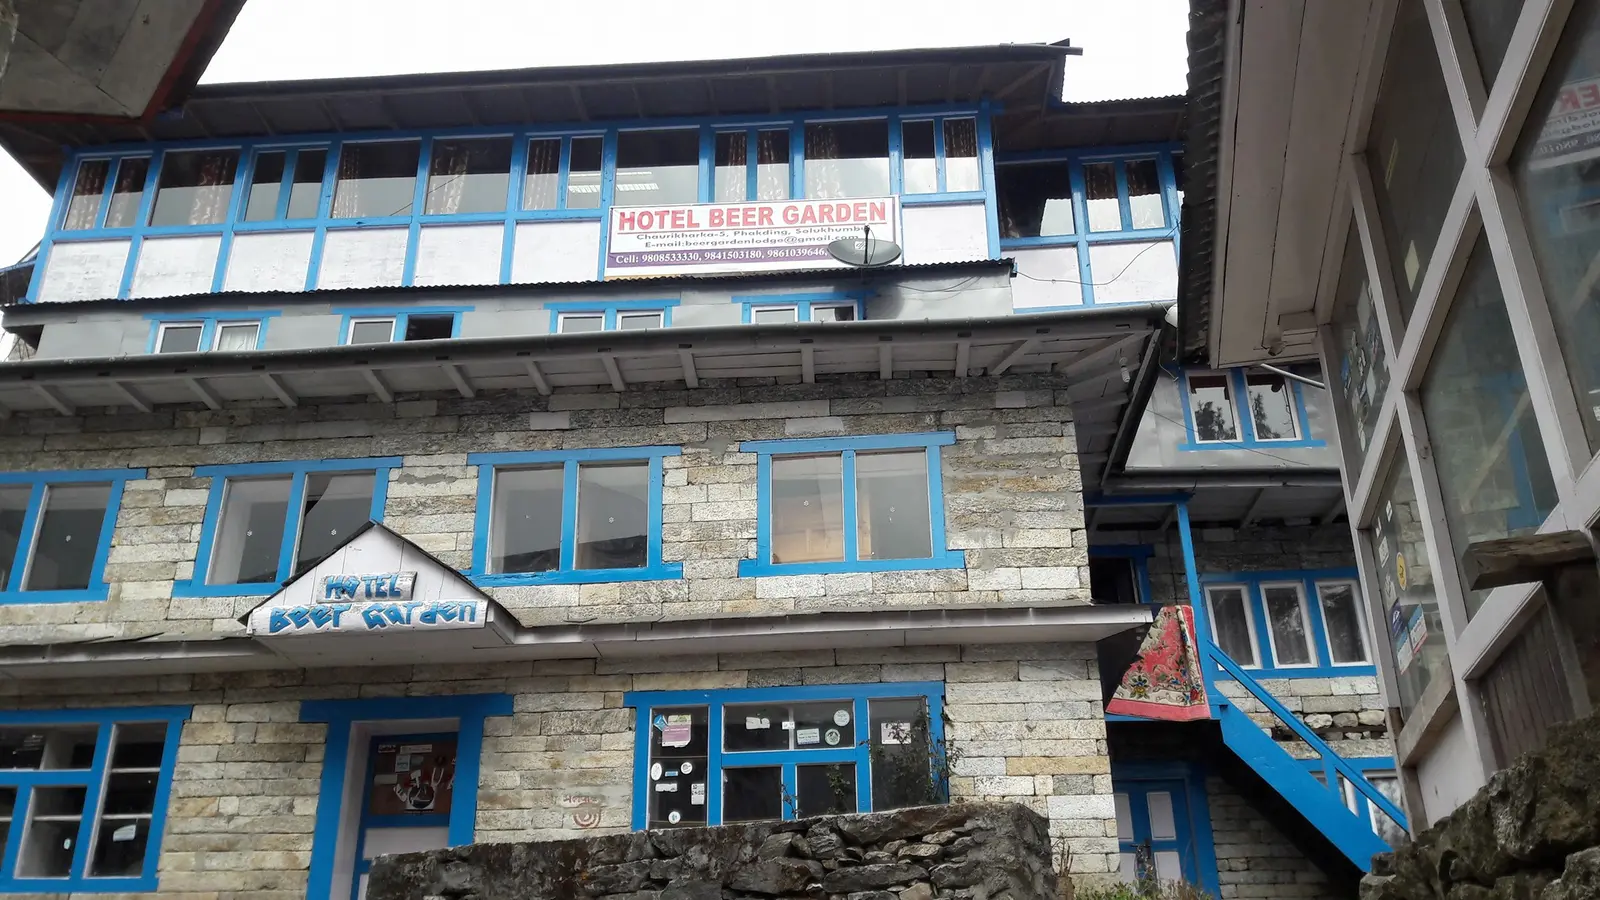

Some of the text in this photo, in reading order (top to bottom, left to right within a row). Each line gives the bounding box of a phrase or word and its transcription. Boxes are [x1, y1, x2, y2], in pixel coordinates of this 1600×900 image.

[619, 202, 886, 231] HOTEL BEER GARDEN
[733, 228, 791, 238] Phakding,
[615, 246, 828, 264] Cell: 9808533330, 9841503180, 9861039646,
[325, 574, 402, 599] HOTEL
